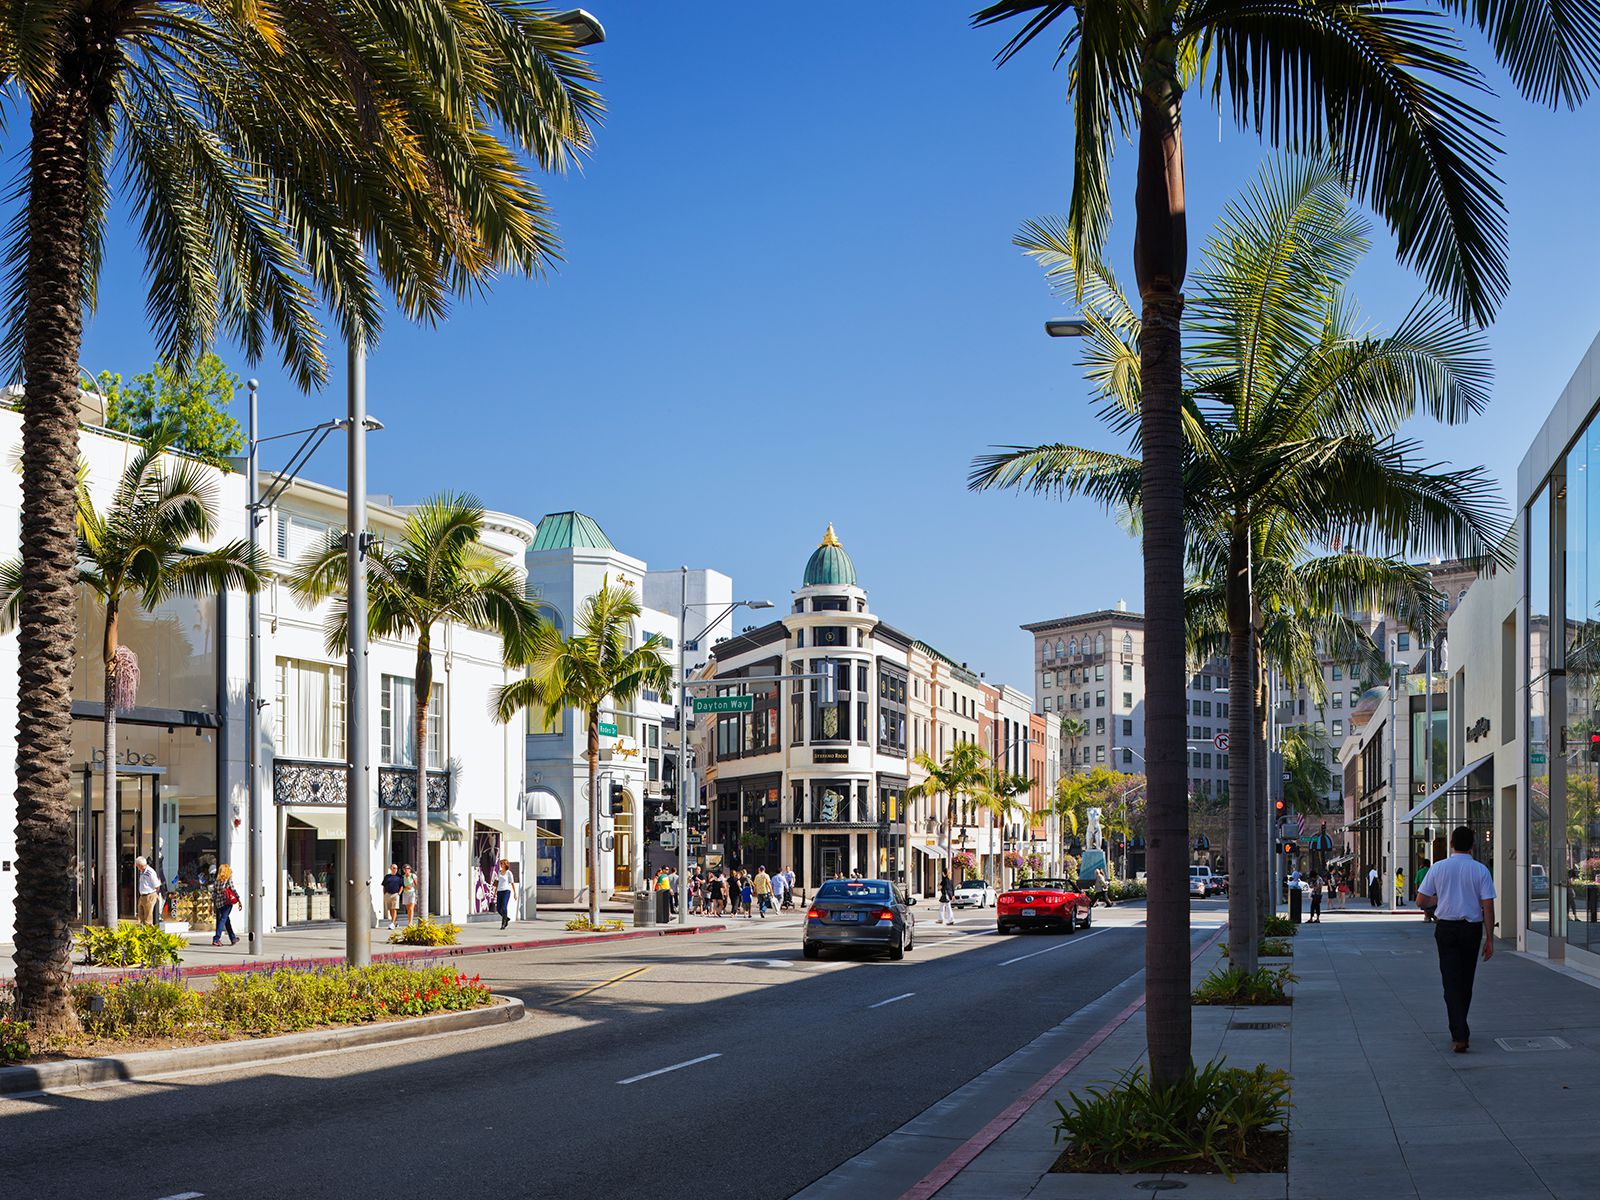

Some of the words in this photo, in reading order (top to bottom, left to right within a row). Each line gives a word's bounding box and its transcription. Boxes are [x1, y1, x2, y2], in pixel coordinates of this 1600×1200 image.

[697, 701, 728, 711] Dayton
[730, 700, 748, 709] Way
[600, 725, 611, 734] Rodeo
